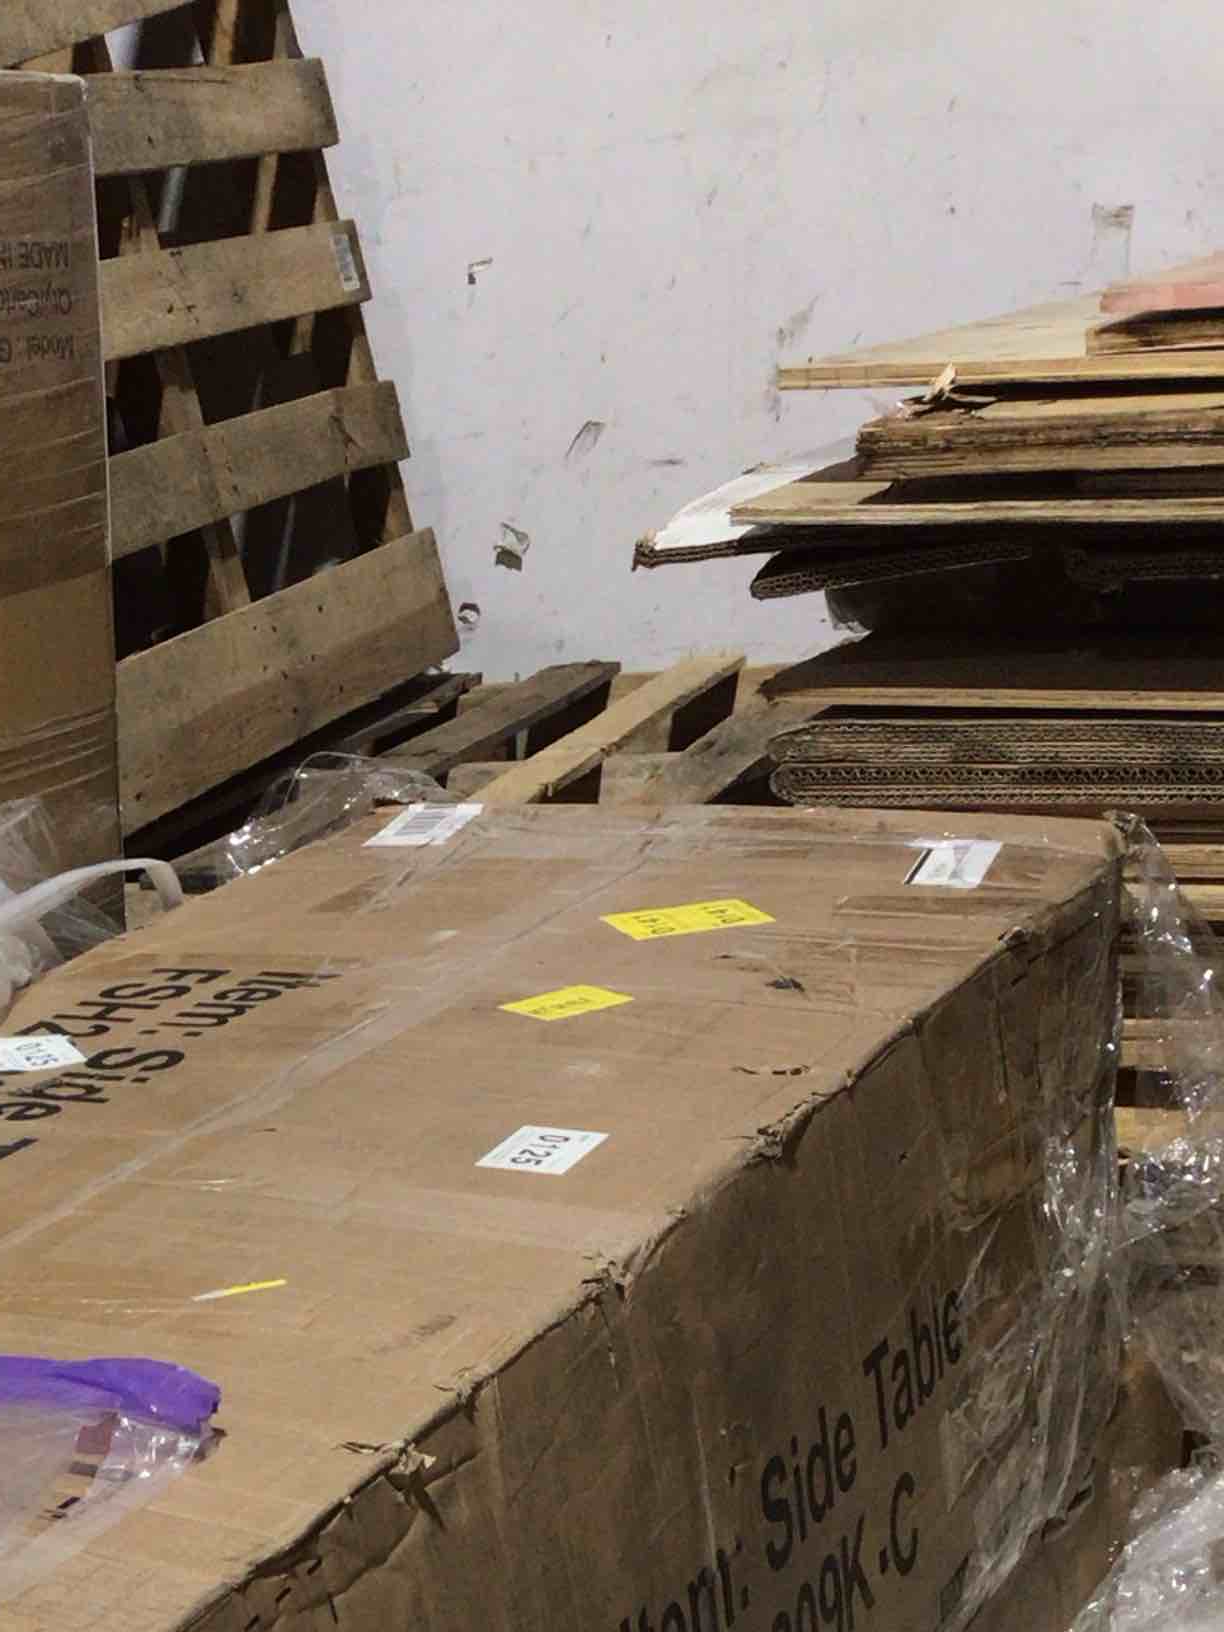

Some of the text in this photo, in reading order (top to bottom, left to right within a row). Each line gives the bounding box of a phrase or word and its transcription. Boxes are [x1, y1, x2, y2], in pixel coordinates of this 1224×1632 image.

[174, 968, 340, 1040] Item:
[759, 1406, 858, 1572] Side
[862, 1288, 970, 1450] Table
